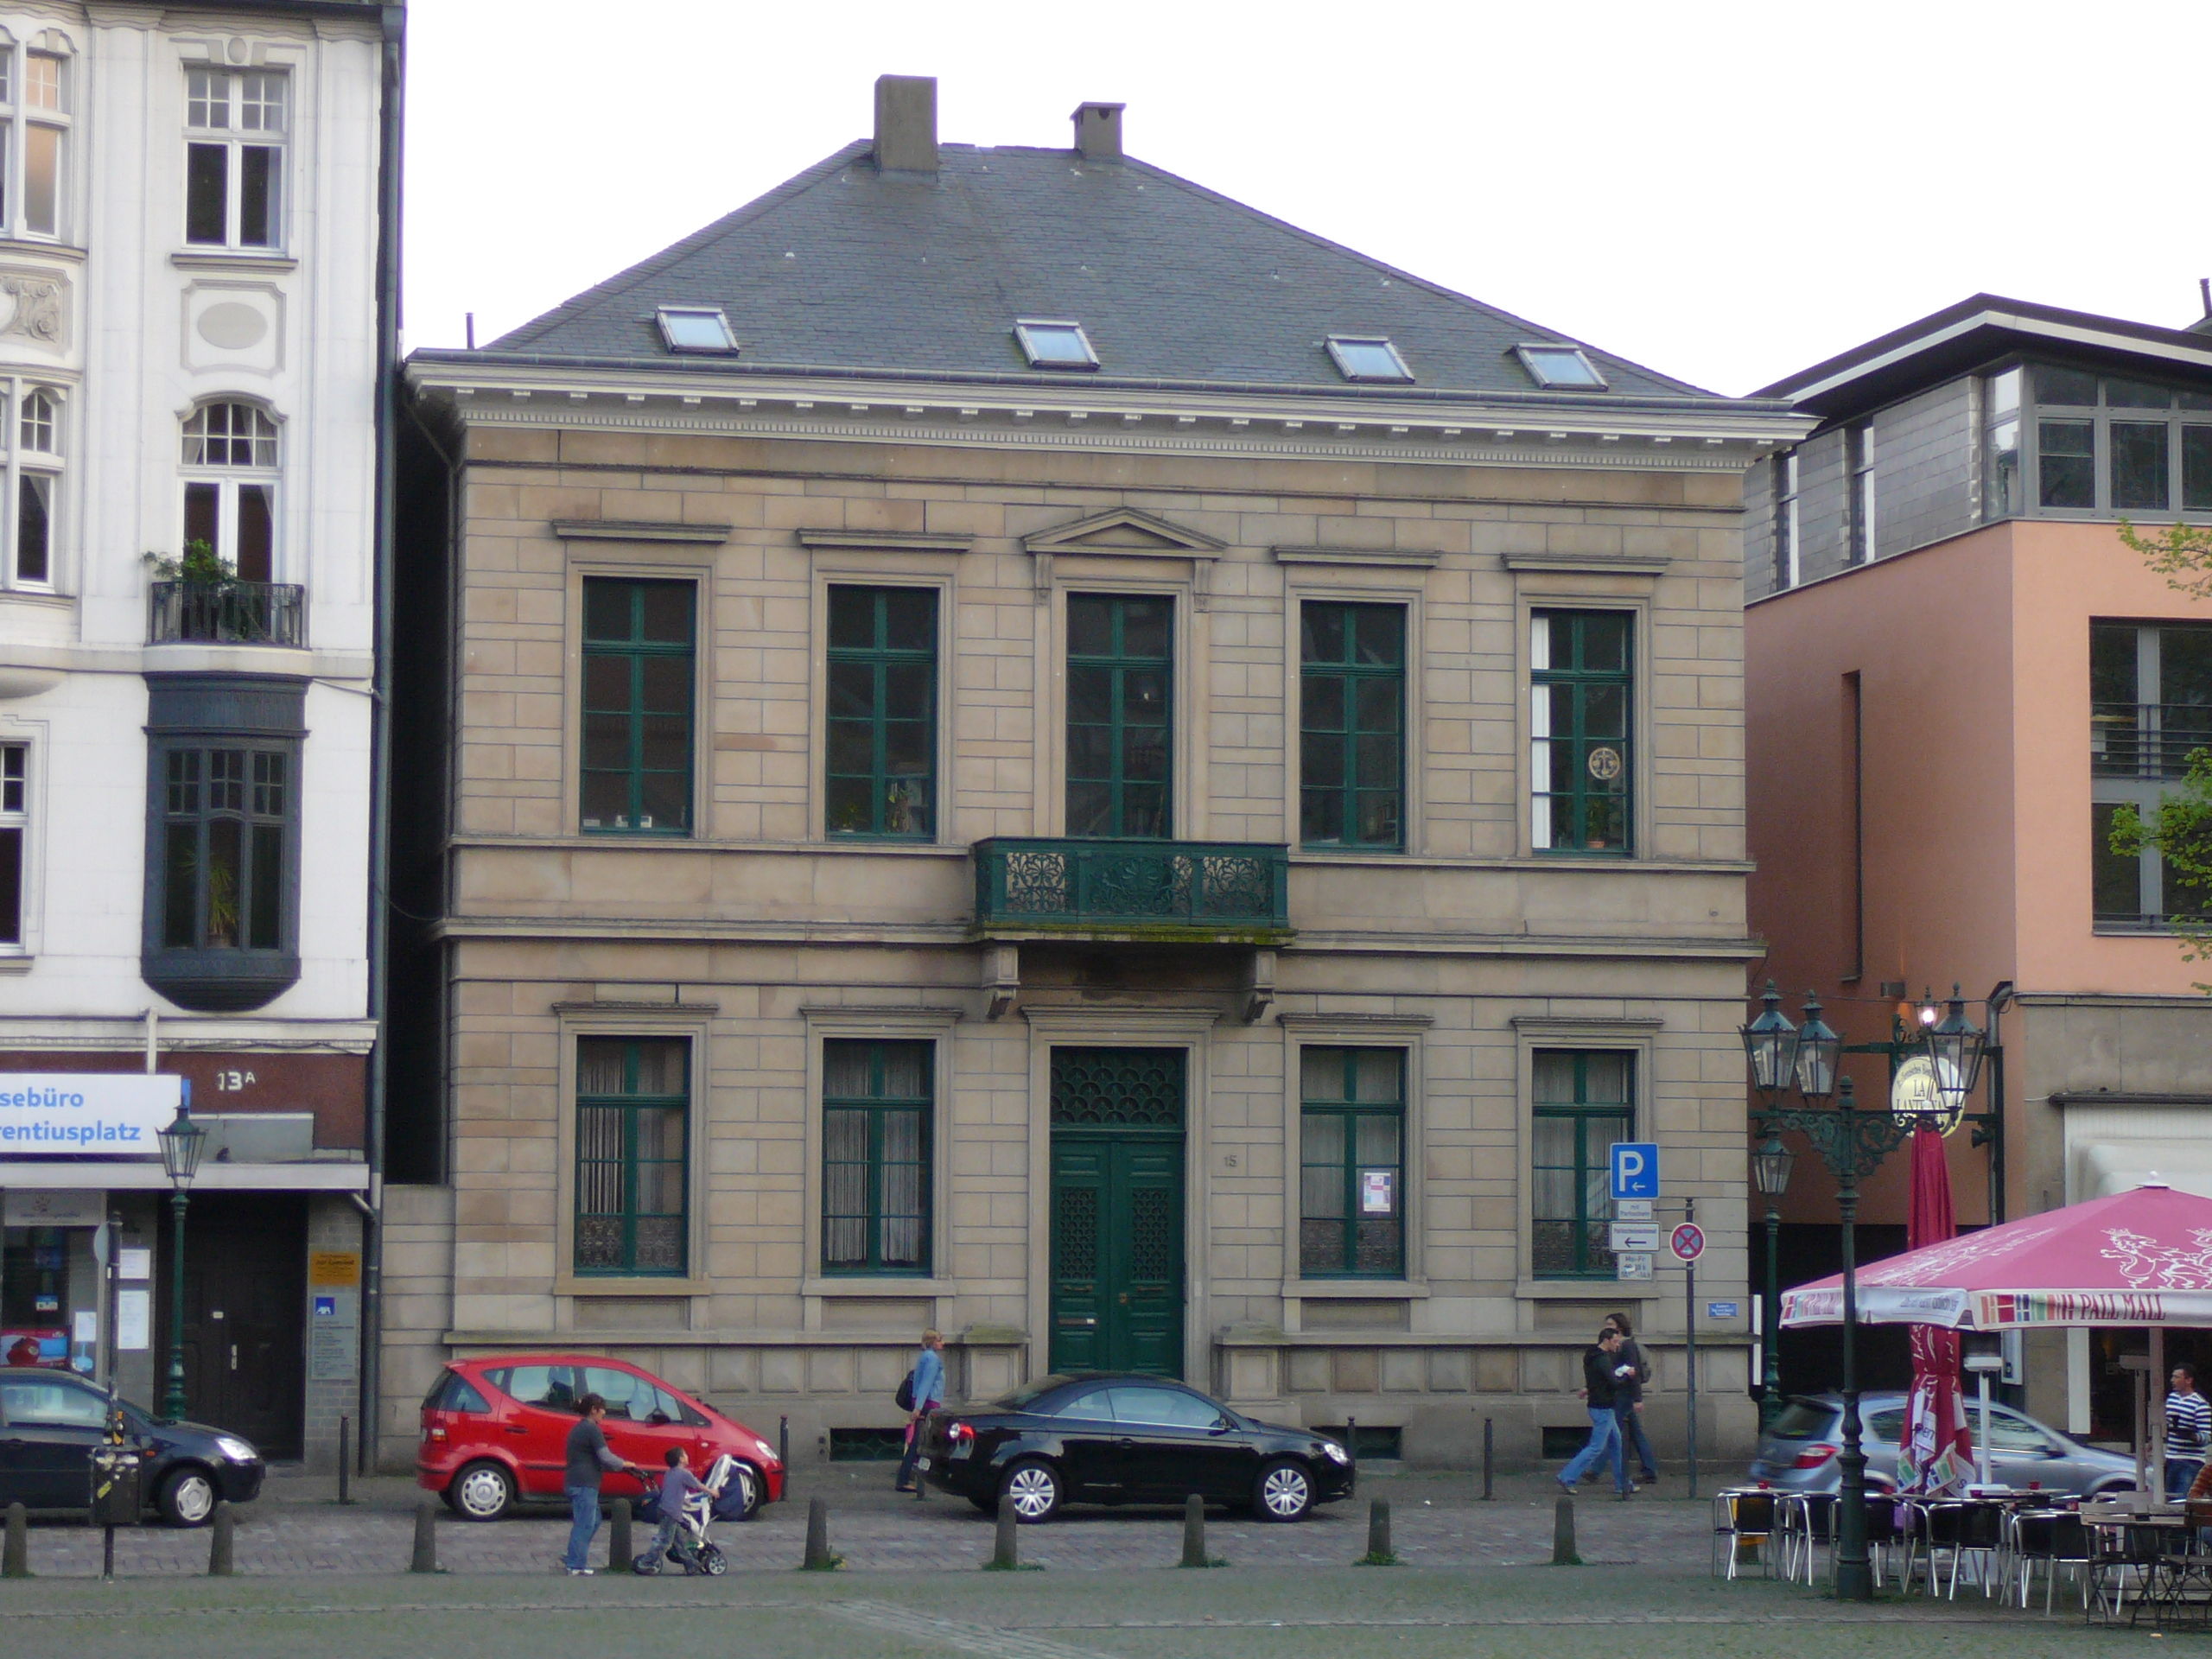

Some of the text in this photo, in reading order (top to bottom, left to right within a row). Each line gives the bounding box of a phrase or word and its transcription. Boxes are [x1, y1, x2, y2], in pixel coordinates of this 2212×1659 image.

[216, 1071, 257, 1091] 13A
[0, 1086, 85, 1108] sebüro
[1223, 1154, 1238, 1167] 15
[1618, 1150, 1645, 1192] P
[2079, 1294, 2166, 1321] PALL MALL
